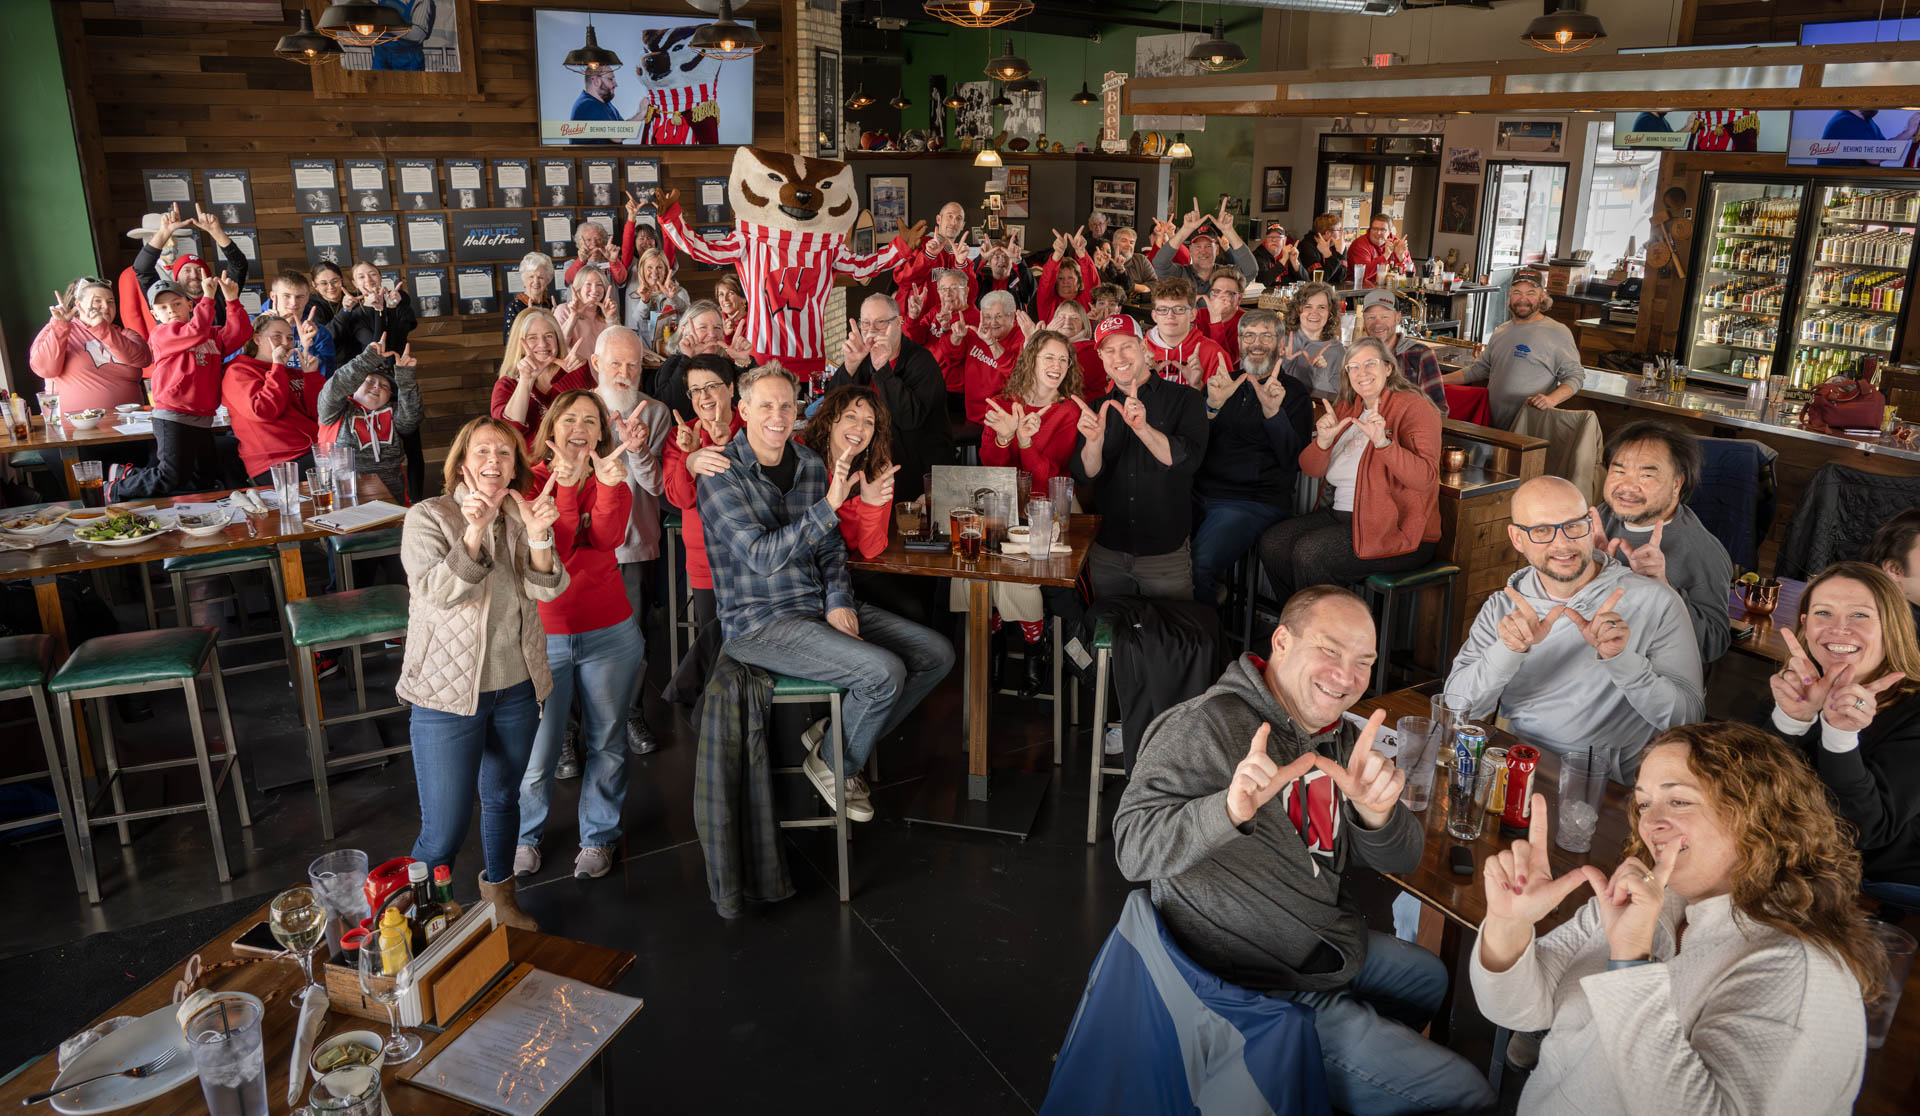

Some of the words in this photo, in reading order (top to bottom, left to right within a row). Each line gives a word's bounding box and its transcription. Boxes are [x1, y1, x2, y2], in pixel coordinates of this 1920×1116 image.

[560, 123, 587, 136] Bucky!
[1809, 141, 1840, 156] Bucky!
[469, 227, 518, 237] ATHLETIC
[463, 235, 488, 246] Hall
[488, 234, 501, 246] of
[498, 234, 525, 245] Fame
[764, 266, 821, 318] W
[351, 406, 393, 451] W
